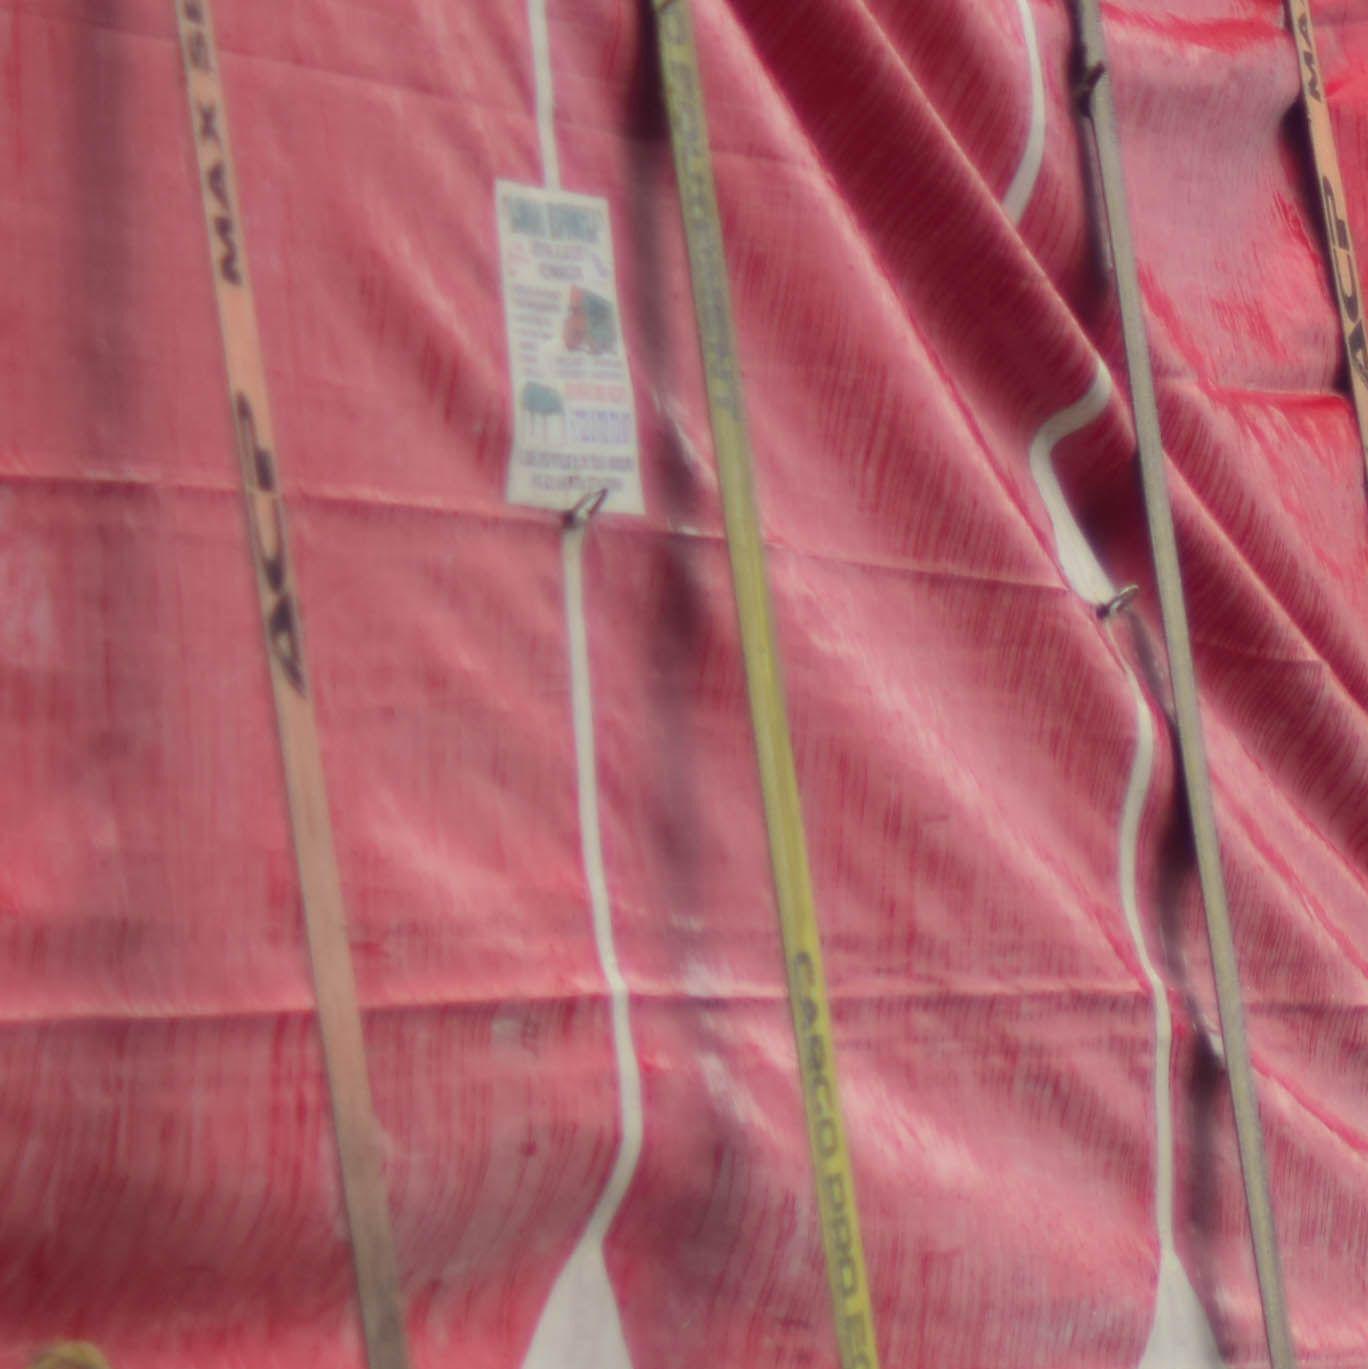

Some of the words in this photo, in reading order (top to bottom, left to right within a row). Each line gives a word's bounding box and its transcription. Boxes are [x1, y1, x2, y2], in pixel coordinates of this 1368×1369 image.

[1297, 13, 1323, 103] MA
[793, 948, 838, 1162] CARGO
[822, 1170, 862, 1300] PRO
